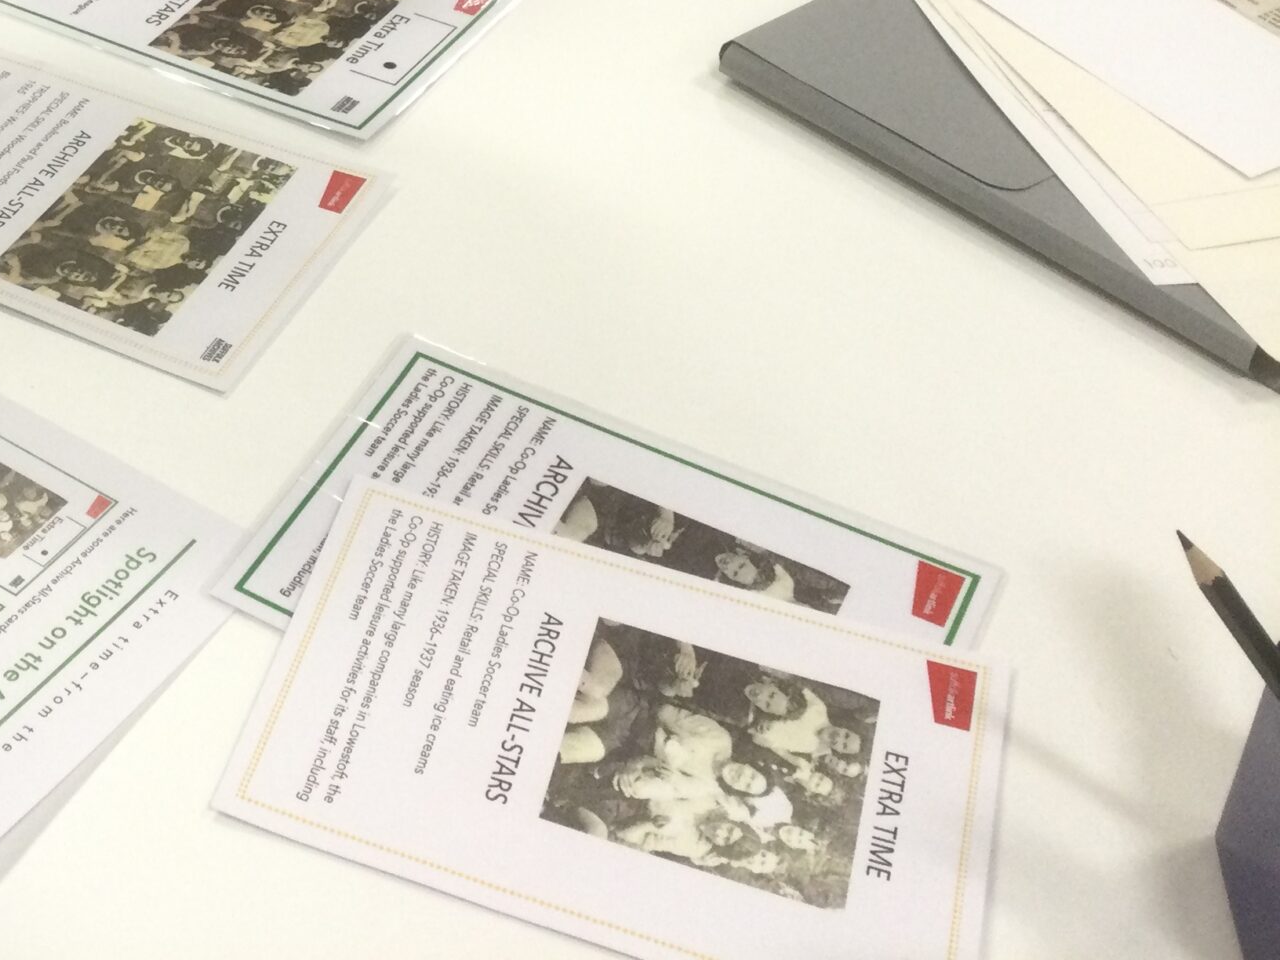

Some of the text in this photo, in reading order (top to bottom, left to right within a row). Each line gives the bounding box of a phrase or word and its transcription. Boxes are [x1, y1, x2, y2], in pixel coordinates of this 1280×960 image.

[344, 13, 412, 66] Extra Time
[37, 129, 93, 180] ARCHIVE
[216, 219, 289, 293] EXTRA TIME
[457, 404, 531, 499] SPECIAL SKILLS: Retail
[489, 415, 558, 505] NAME: Co-Op Ladies
[113, 506, 139, 527] Here
[511, 453, 575, 529] ARCHIV
[21, 515, 65, 552] Extra Time
[79, 536, 105, 559] some
[100, 523, 118, 539] are
[453, 530, 479, 570] IMAGE
[49, 555, 84, 586] Archive
[64, 546, 158, 627] Spotlight
[347, 507, 405, 622] the Ladies Soccer team
[439, 568, 467, 608] TAKEN:
[16, 582, 54, 616] All-Stars
[131, 588, 181, 631] Extra
[37, 625, 68, 651] on
[294, 514, 425, 804] Co-Op supported leisure activities for its staff, including
[322, 520, 445, 805] HISTORY: Like many large companies in Lowestoft, the
[413, 540, 509, 776] SPECIAL SKILLS: Retail and eating ice creams
[466, 550, 540, 729] NAME: Co-Op Ladies Soccer team
[2, 651, 44, 683] the
[401, 667, 425, 709] season
[484, 610, 565, 806] ARCHIVE ALL-STARS
[0, 724, 35, 753] the
[864, 749, 910, 883] EXTRA TIME
